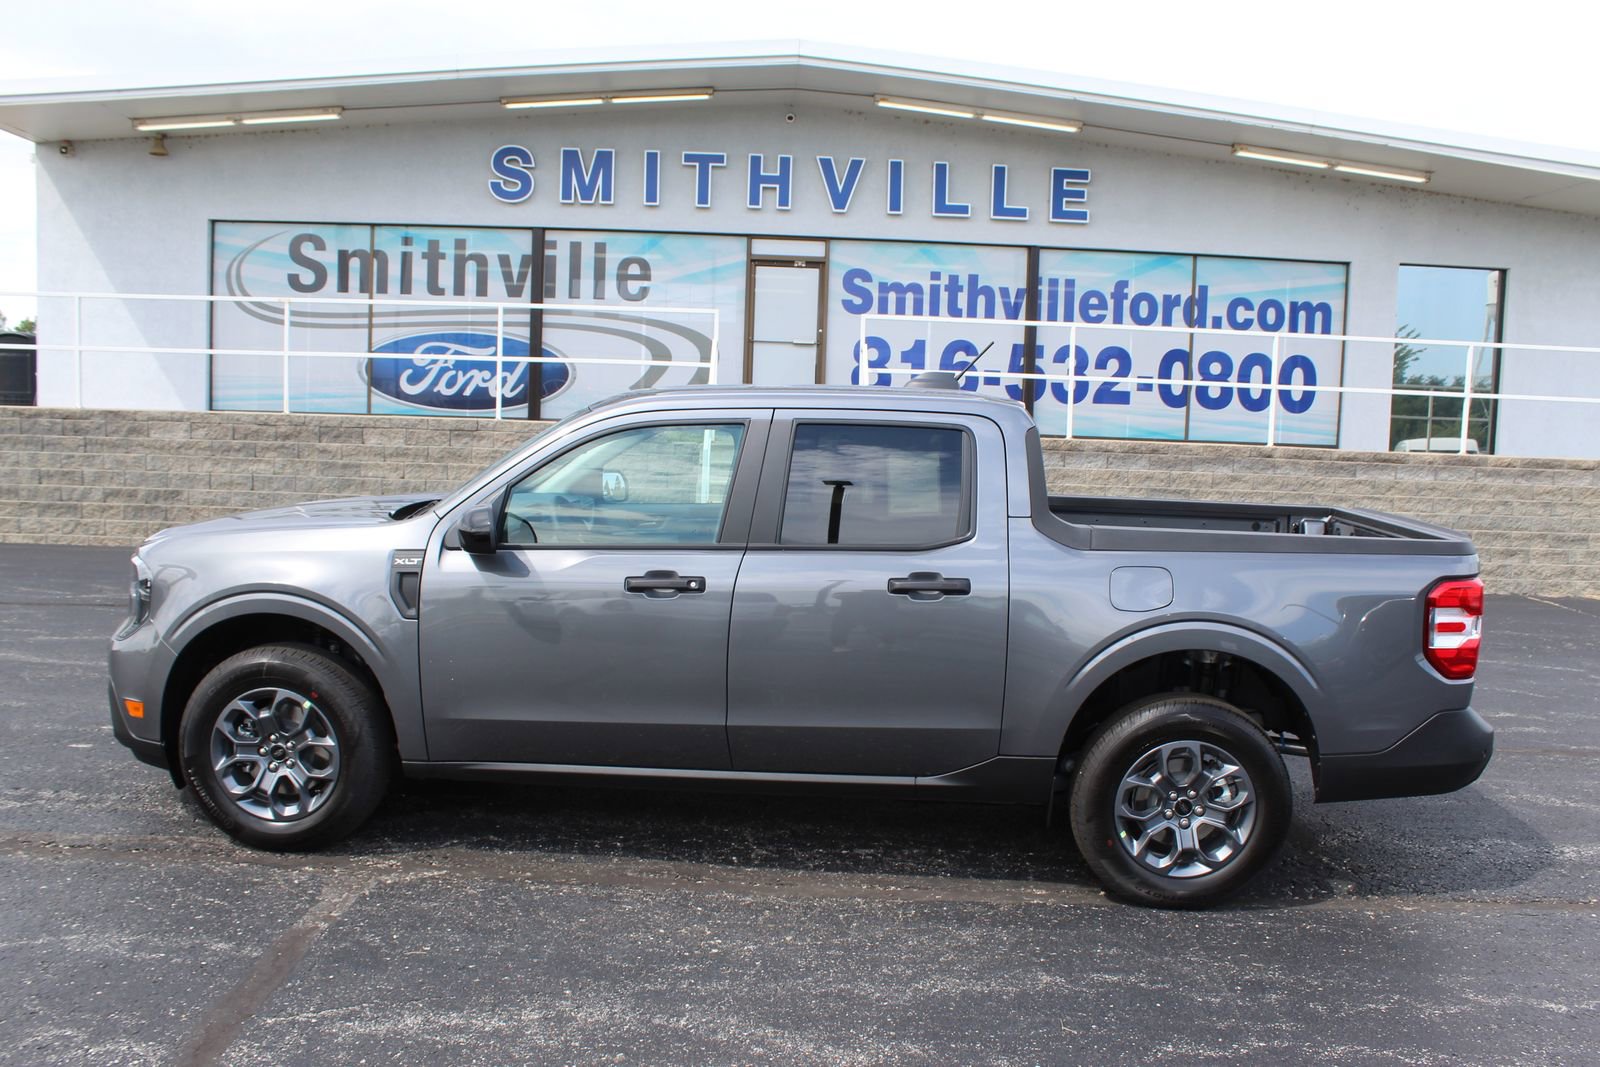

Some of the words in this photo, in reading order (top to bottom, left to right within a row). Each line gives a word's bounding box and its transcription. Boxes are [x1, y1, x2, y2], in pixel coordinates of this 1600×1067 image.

[488, 145, 1091, 224] SMITHVILLE
[287, 233, 652, 302] Smithville
[400, 341, 528, 399] Ford
